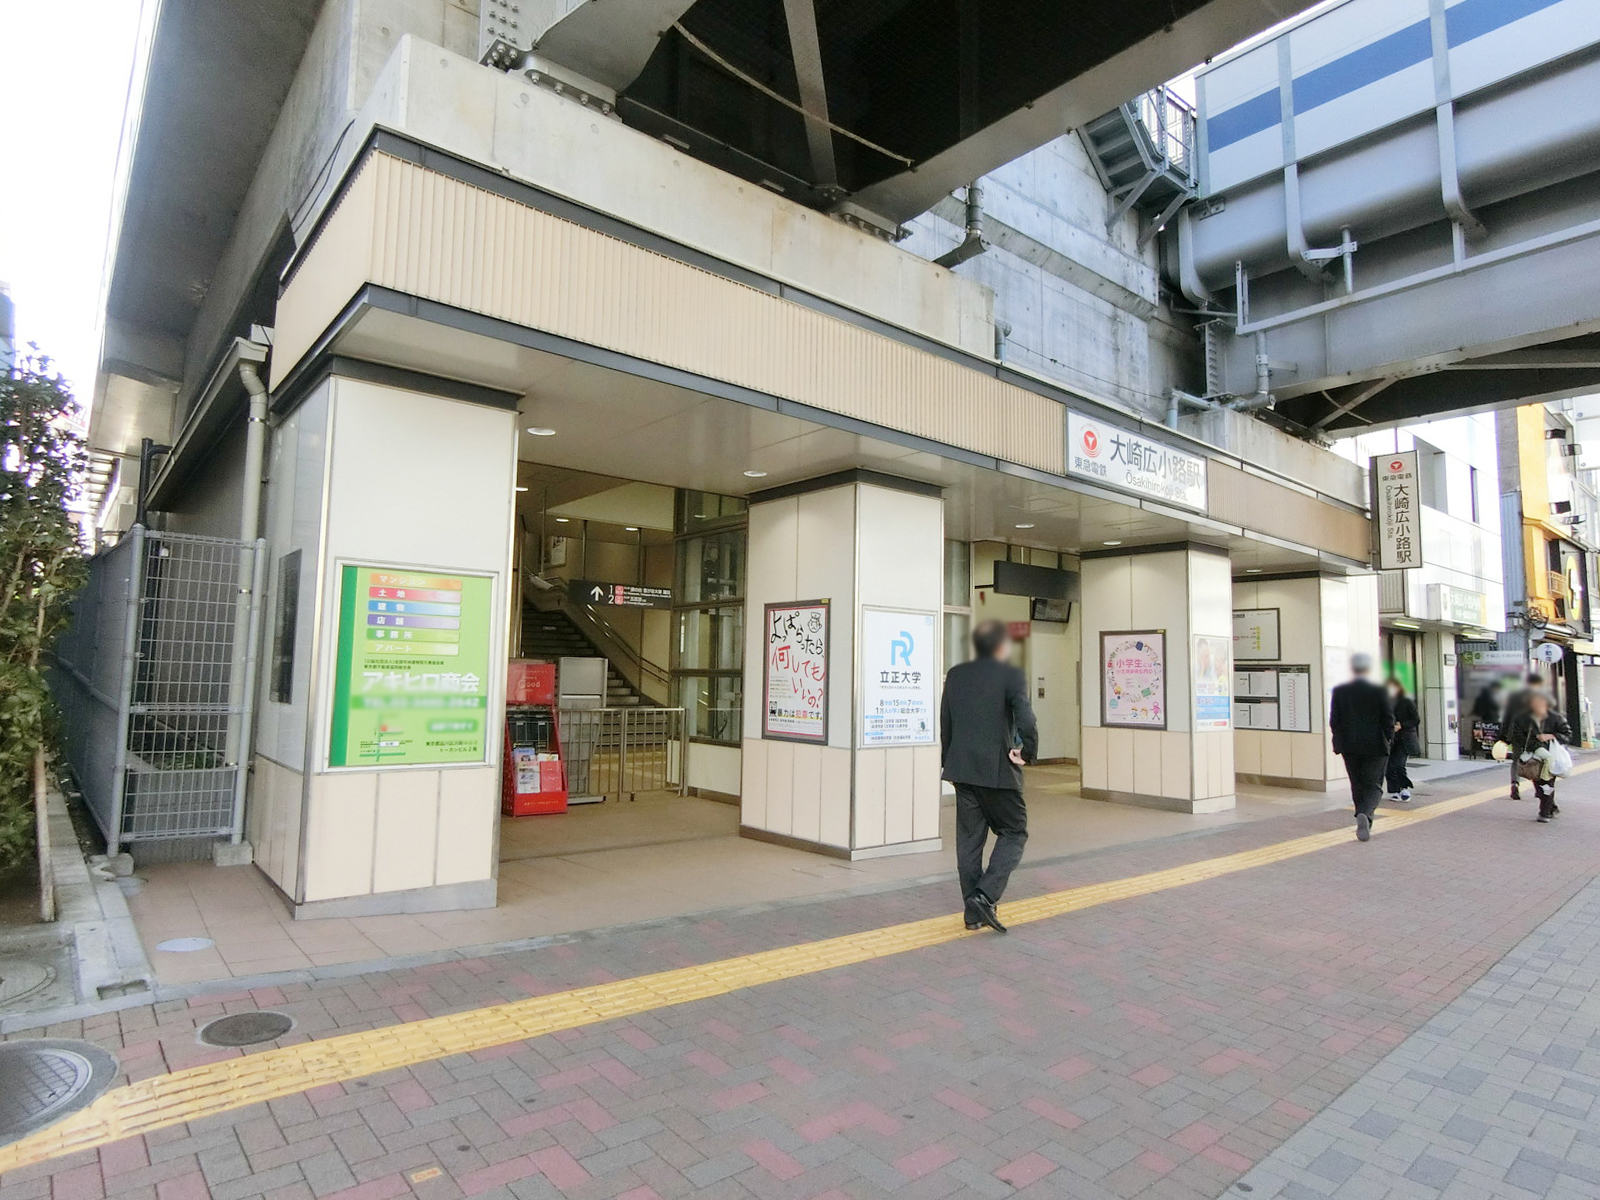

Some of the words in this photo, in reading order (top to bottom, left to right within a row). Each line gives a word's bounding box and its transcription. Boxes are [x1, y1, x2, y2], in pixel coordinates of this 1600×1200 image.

[1074, 456, 1108, 478] 東急電鉄
[1110, 434, 1200, 489] 大崎広小路駅
[1381, 473, 1413, 482] 東急電鉄
[1393, 483, 1412, 564] 大崎広小路駅
[378, 574, 427, 586] マンション
[608, 595, 614, 604] 2
[376, 630, 414, 640] 事務所
[375, 643, 413, 652] アパート
[362, 671, 480, 693] アキヒロ商会
[880, 671, 922, 684] 立正大学
